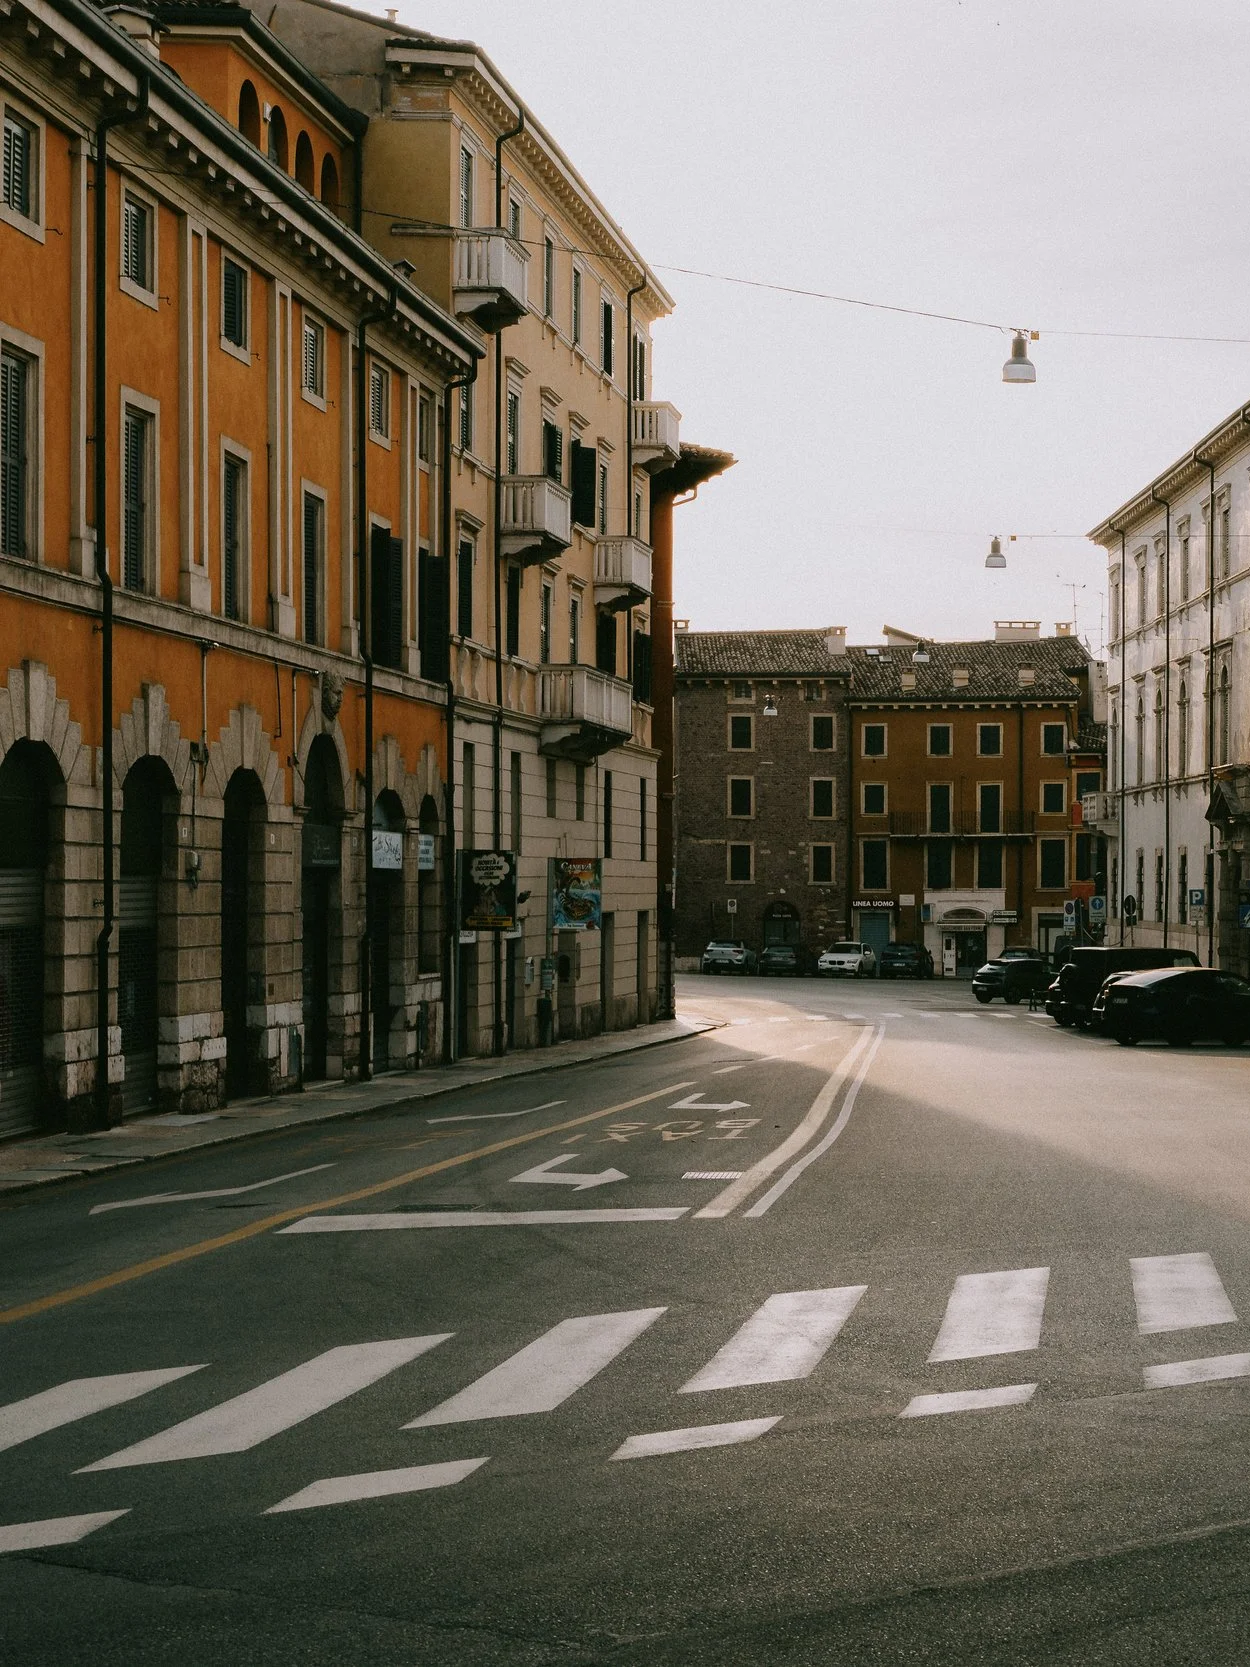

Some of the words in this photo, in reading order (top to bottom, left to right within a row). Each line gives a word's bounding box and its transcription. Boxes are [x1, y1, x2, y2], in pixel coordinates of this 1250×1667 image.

[1192, 891, 1202, 904] P
[601, 1118, 763, 1131] BUS
[560, 1130, 748, 1144] TAXI
